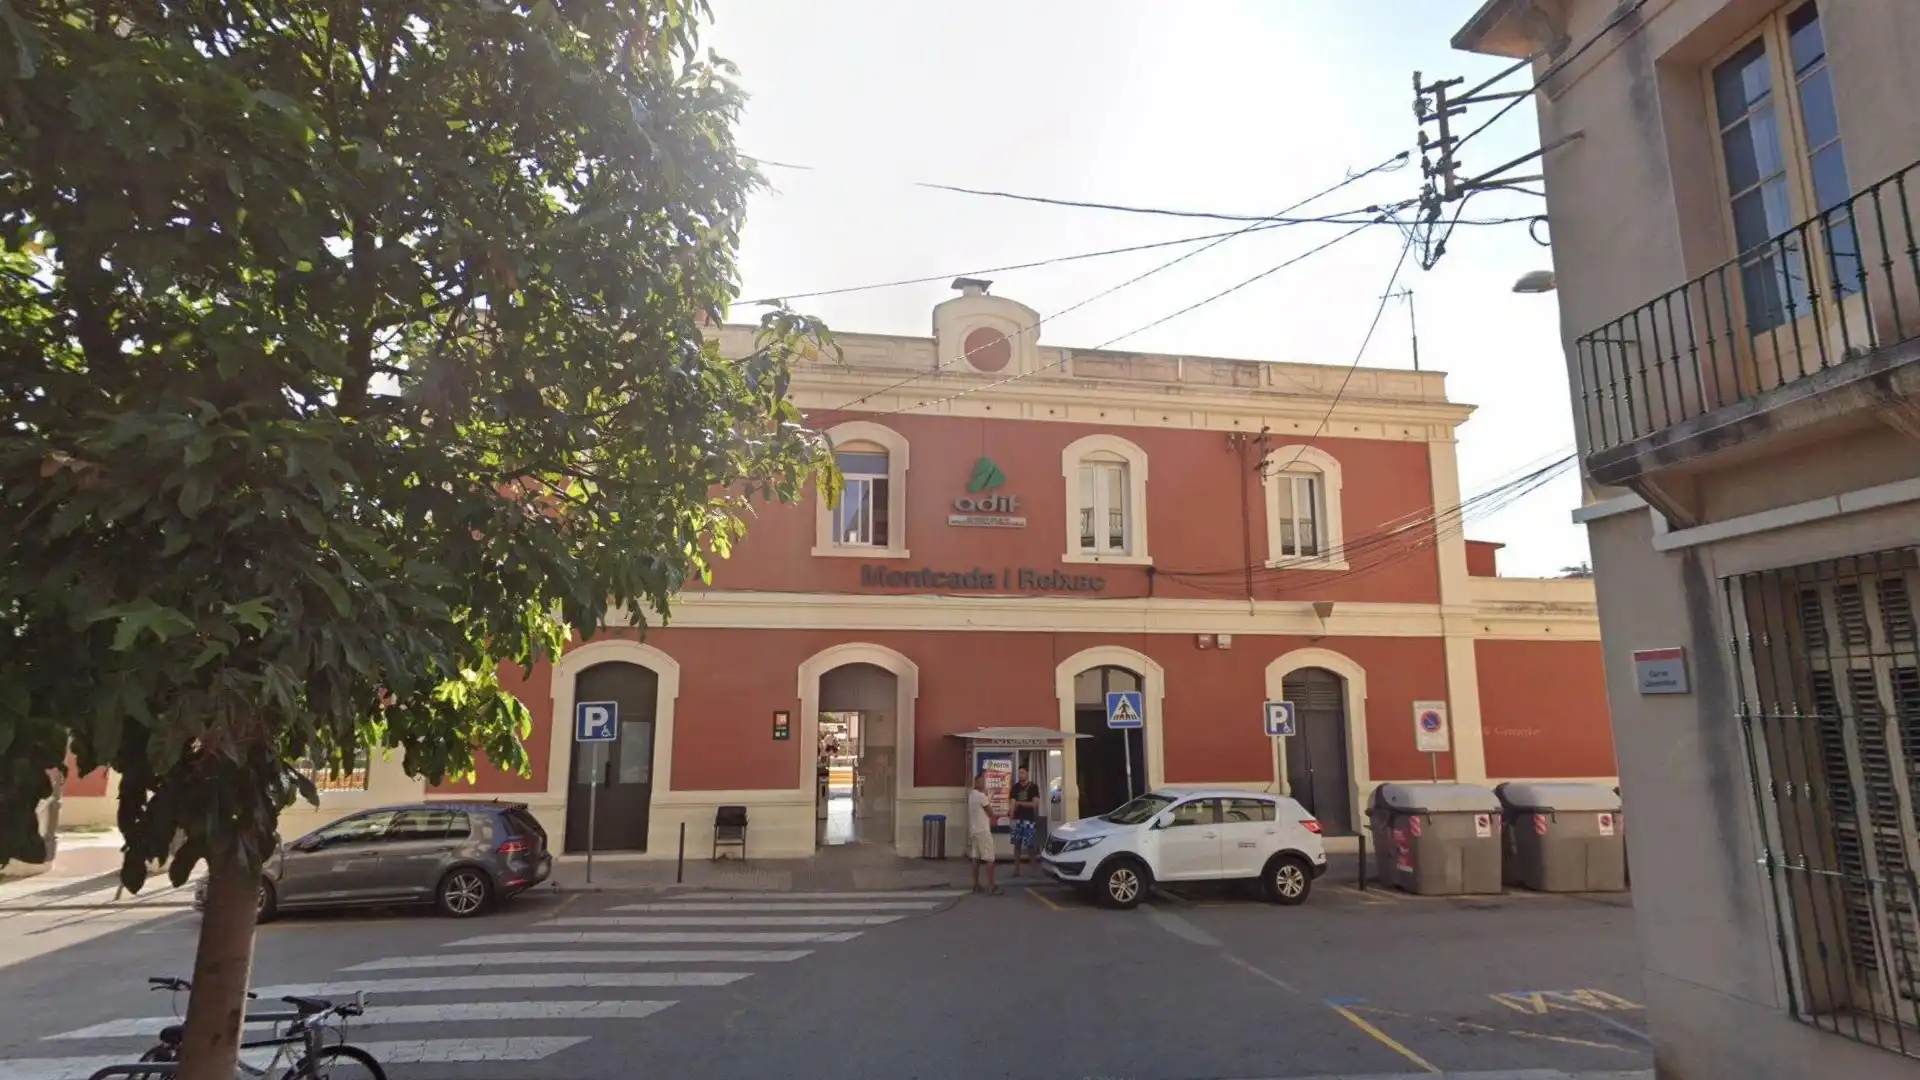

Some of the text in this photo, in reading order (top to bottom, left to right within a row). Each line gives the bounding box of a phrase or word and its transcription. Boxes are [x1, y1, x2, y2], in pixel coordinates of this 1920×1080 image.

[953, 493, 1020, 513] adif
[860, 564, 996, 590] Montcada
[1018, 568, 1106, 591] Reixac
[584, 706, 608, 737] P
[1270, 705, 1288, 732] P
